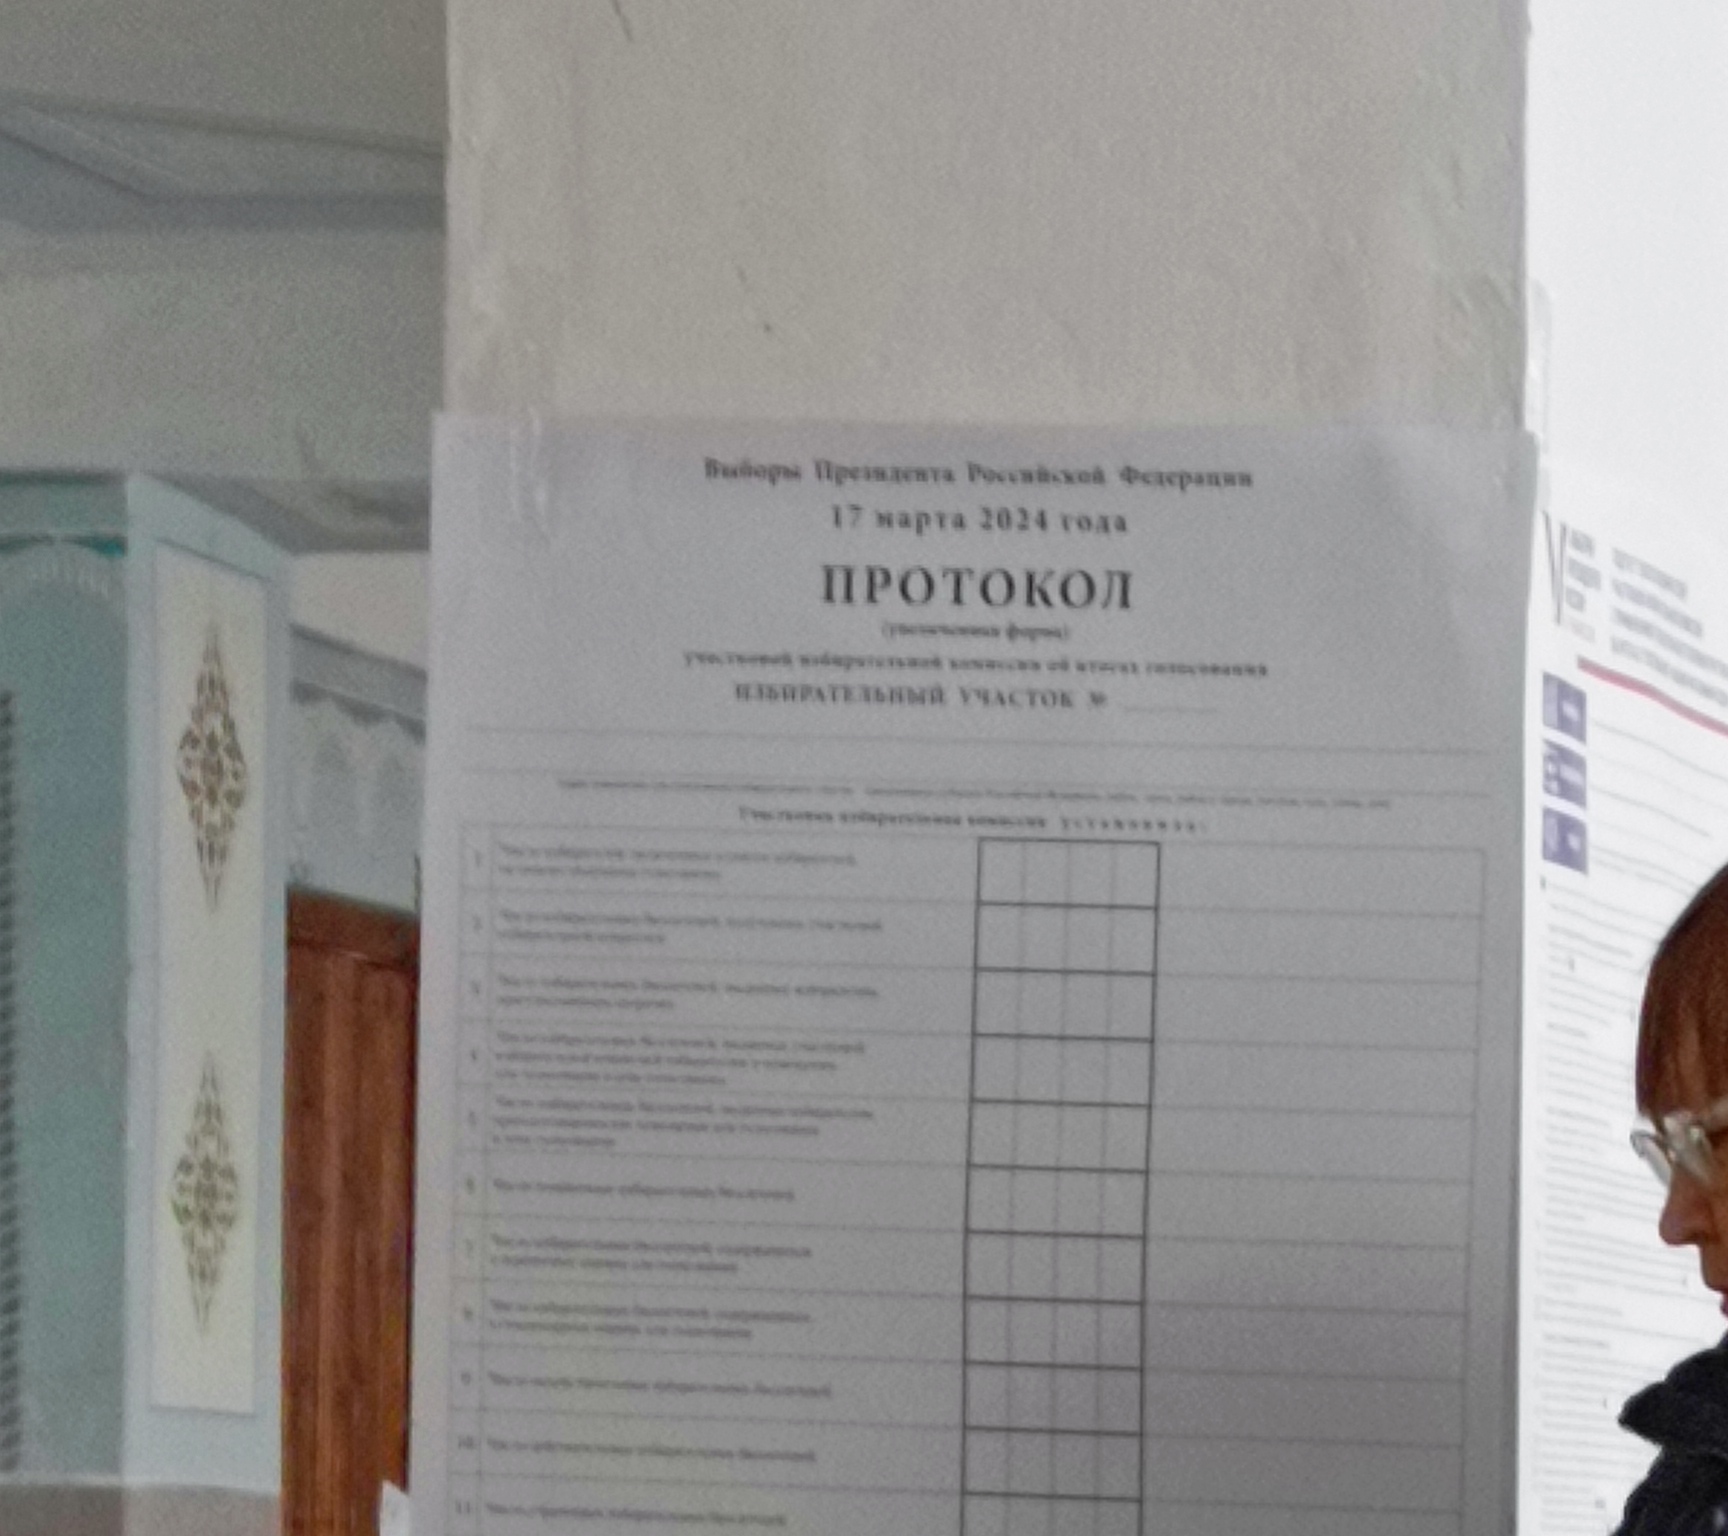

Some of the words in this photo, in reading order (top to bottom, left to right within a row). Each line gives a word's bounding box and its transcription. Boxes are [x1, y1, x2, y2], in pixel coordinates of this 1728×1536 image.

[831, 503, 863, 529] 17
[874, 508, 967, 536] марта
[979, 506, 1049, 533] 2024
[1061, 512, 1128, 534] года
[822, 563, 1133, 610] ПРОТОКОЛ
